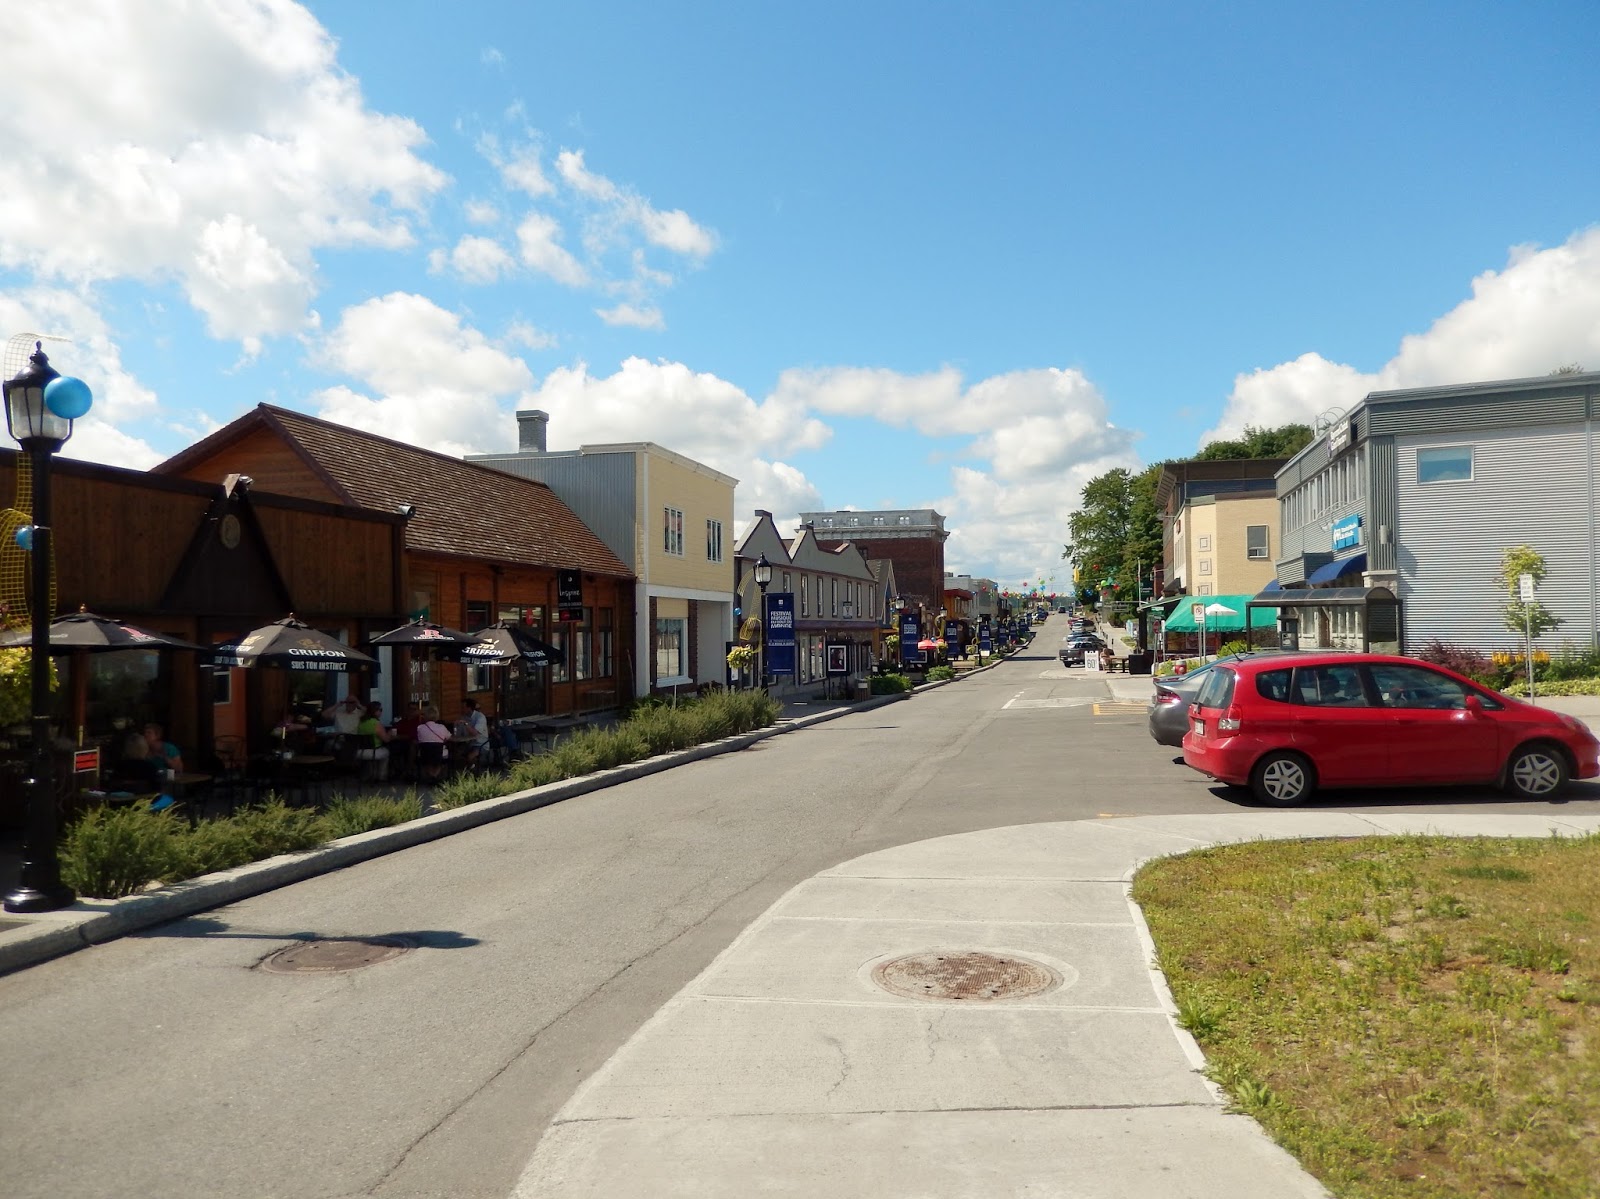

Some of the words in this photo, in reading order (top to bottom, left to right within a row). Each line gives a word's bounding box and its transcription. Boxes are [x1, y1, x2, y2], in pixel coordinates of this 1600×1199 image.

[288, 648, 347, 658] GRIFFON
[461, 646, 505, 656] GRIFFON
[291, 660, 305, 669] SUIS
[306, 661, 318, 670] TON
[318, 662, 347, 671] INSTINCT
